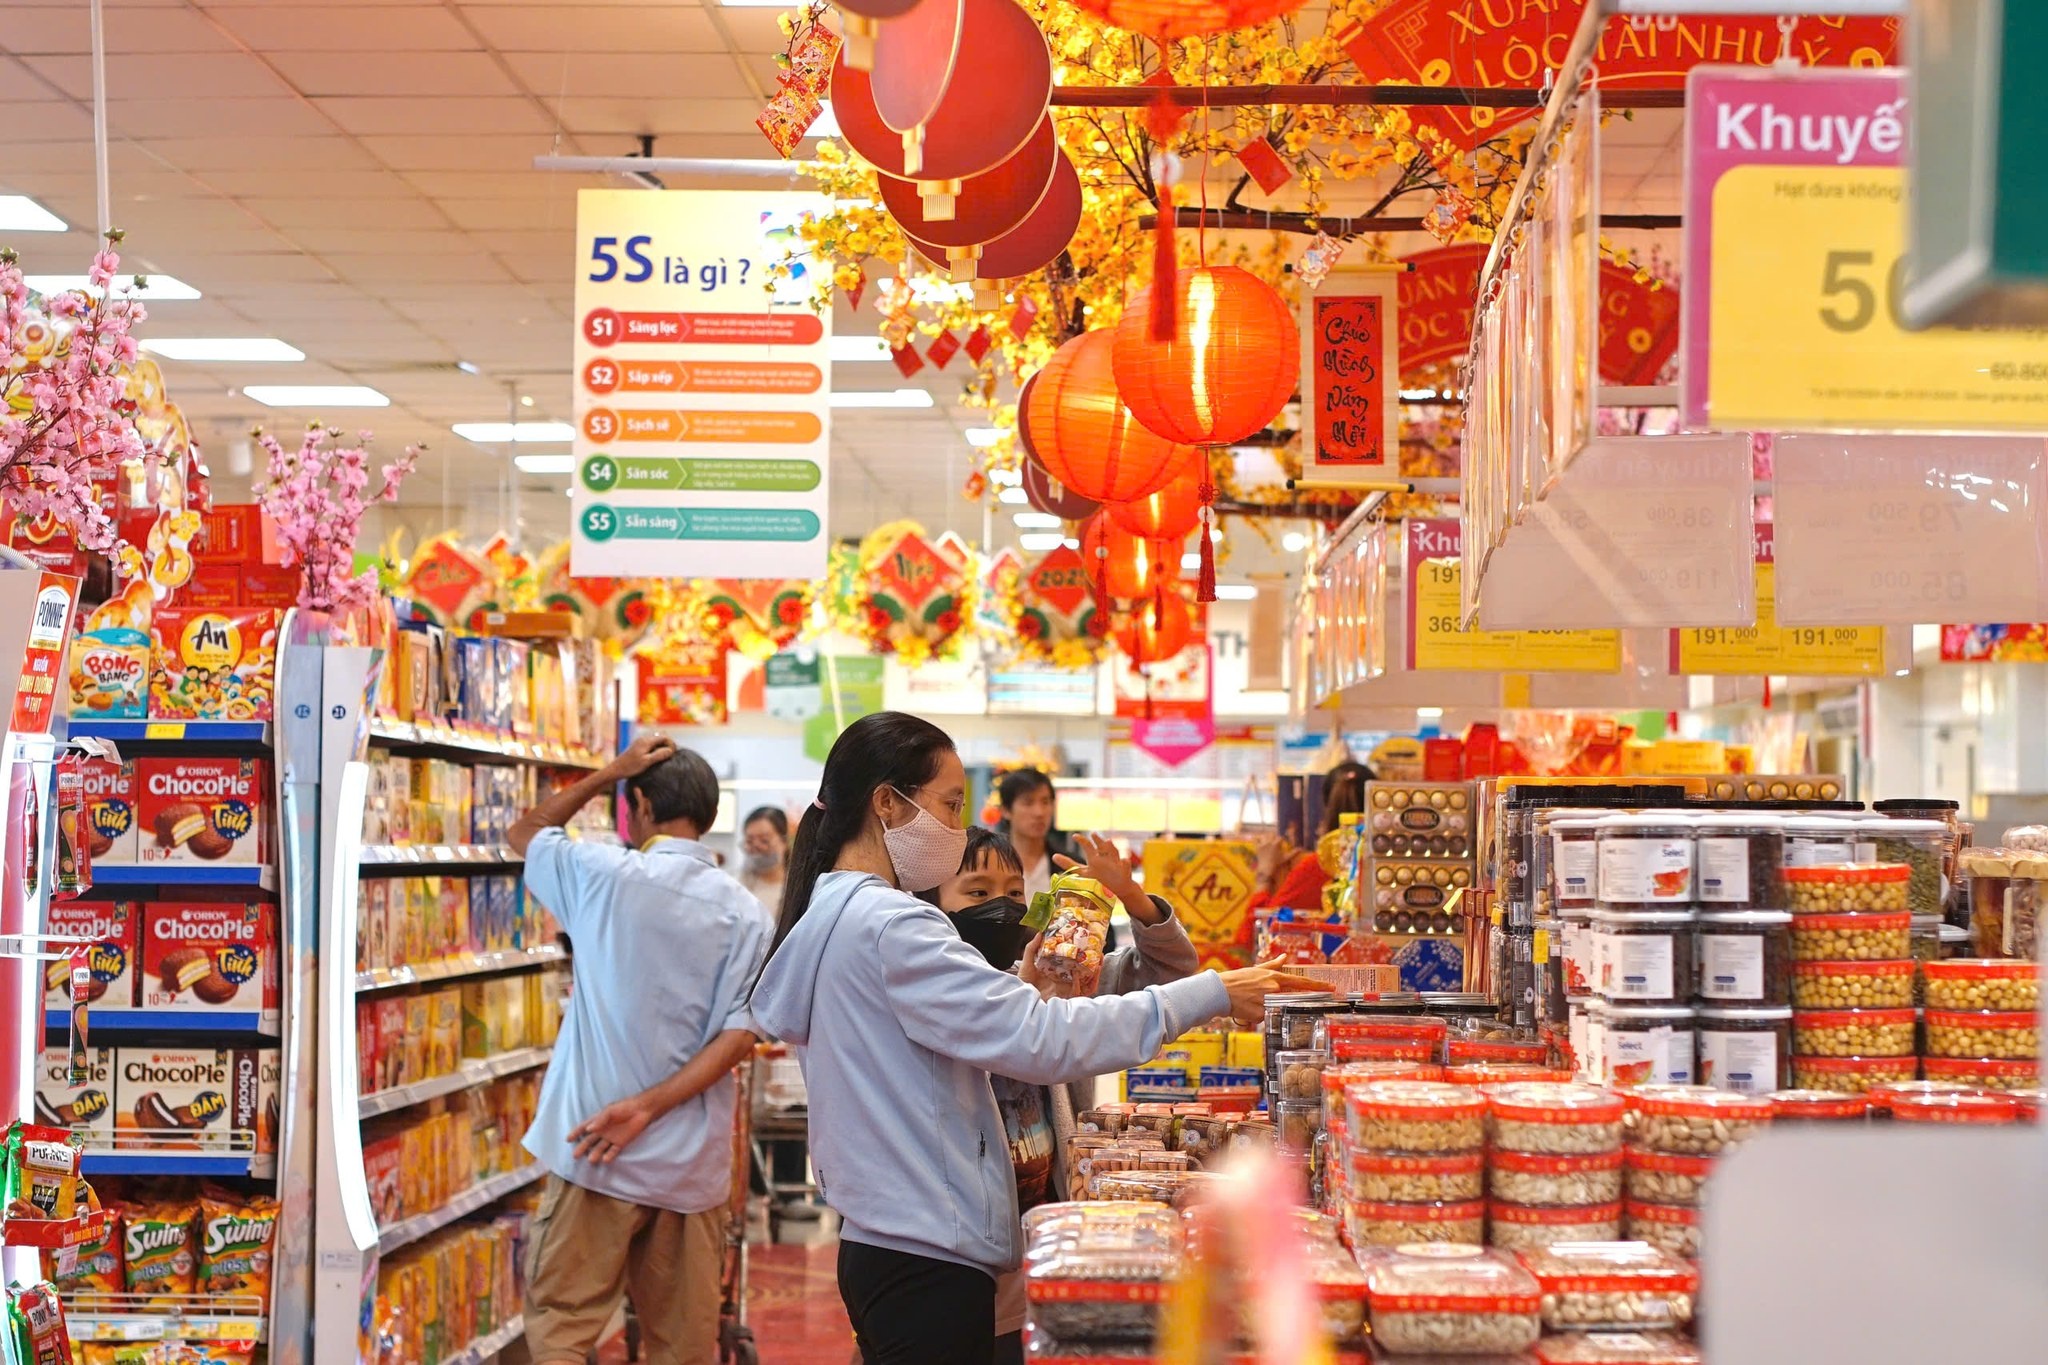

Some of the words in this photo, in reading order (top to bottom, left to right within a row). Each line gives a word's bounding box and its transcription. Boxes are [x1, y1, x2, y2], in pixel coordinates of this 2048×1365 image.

[1716, 99, 1909, 164] Khuyế
[588, 235, 654, 283] 5S
[664, 256, 690, 284] là
[699, 257, 728, 292] gì
[738, 258, 751, 285] ?
[592, 317, 613, 337] S1
[1402, 311, 1450, 349] ỘC
[591, 366, 613, 386] S2
[590, 416, 613, 435] S3
[589, 462, 612, 481] S4
[588, 512, 611, 531] S5
[1418, 531, 1461, 552] Khu
[191, 620, 229, 651] An
[84, 775, 129, 795] oPie
[148, 773, 250, 795] ChocoPie
[48, 918, 124, 938] ocoPie
[154, 918, 255, 940] ChocoPie
[124, 1062, 225, 1083] ChocoPie
[204, 1216, 274, 1254] Swing
